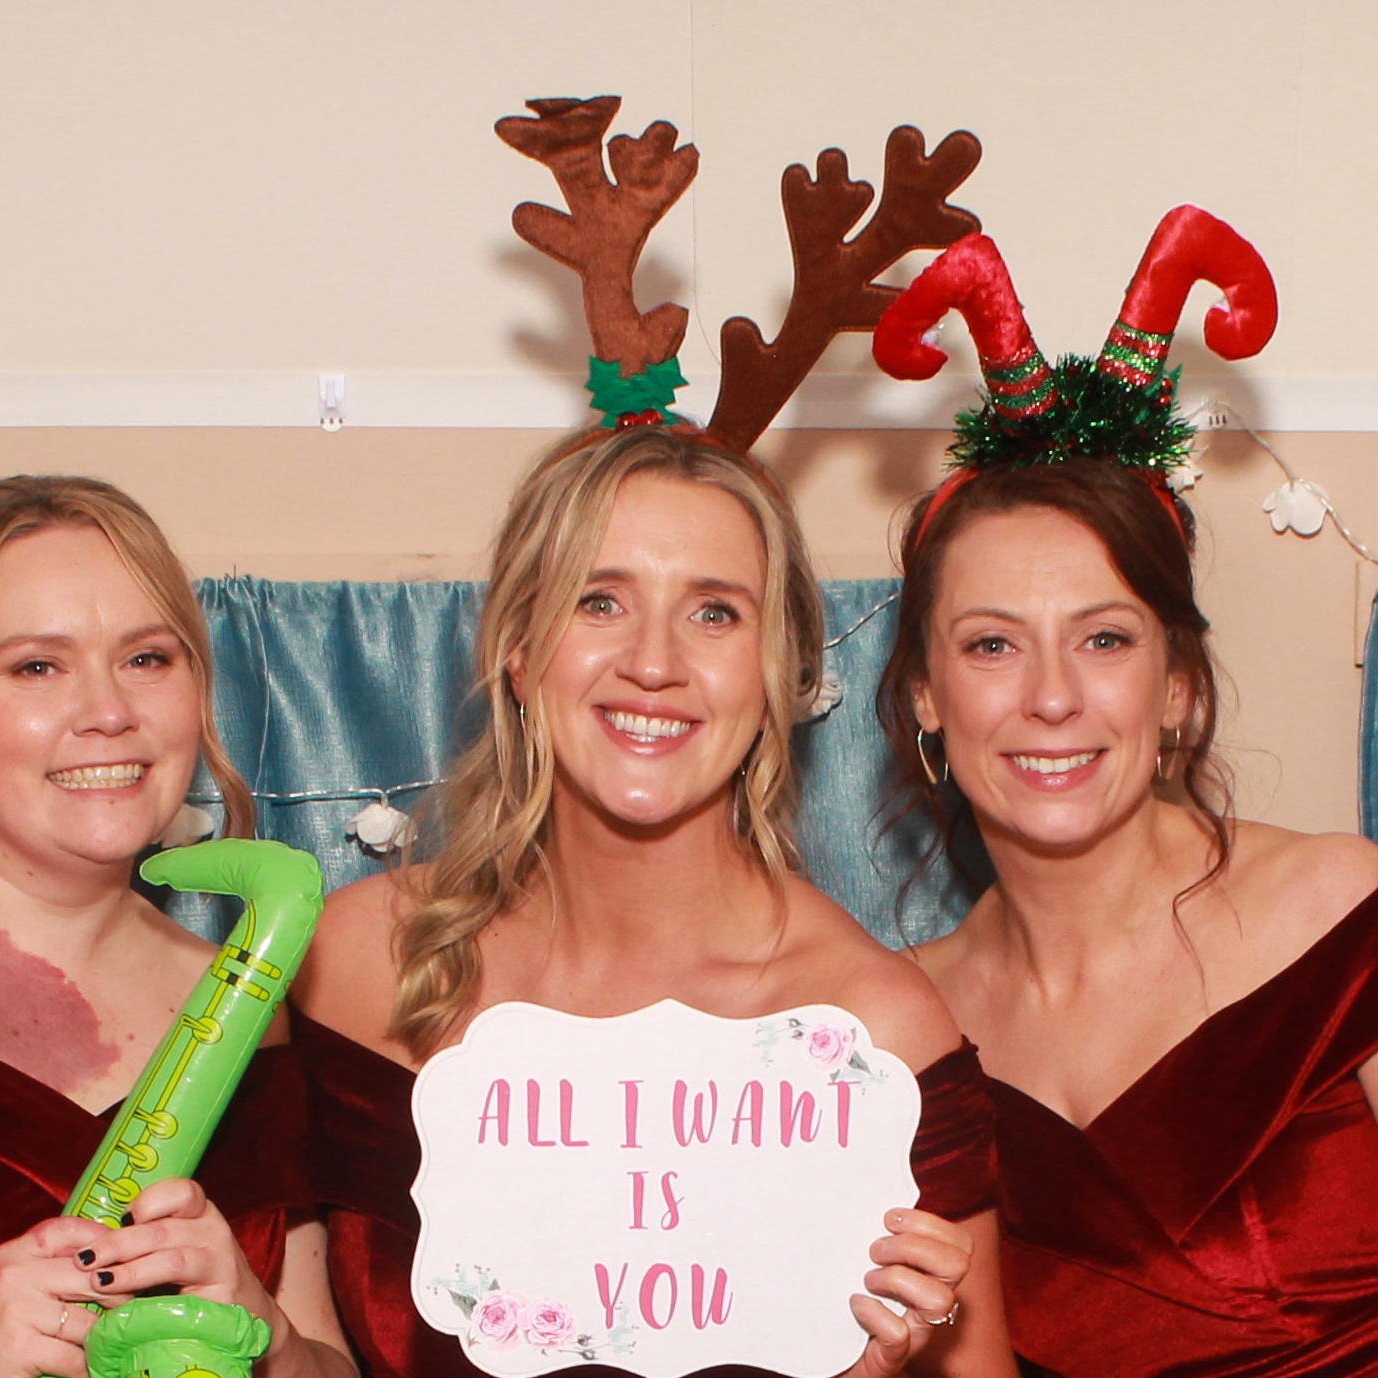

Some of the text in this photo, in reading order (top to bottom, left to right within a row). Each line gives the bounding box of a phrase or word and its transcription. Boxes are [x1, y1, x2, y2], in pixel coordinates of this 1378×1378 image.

[478, 1078, 861, 1149] ALL I WANT
[626, 1170, 685, 1231] IS
[594, 1263, 734, 1330] YOU
